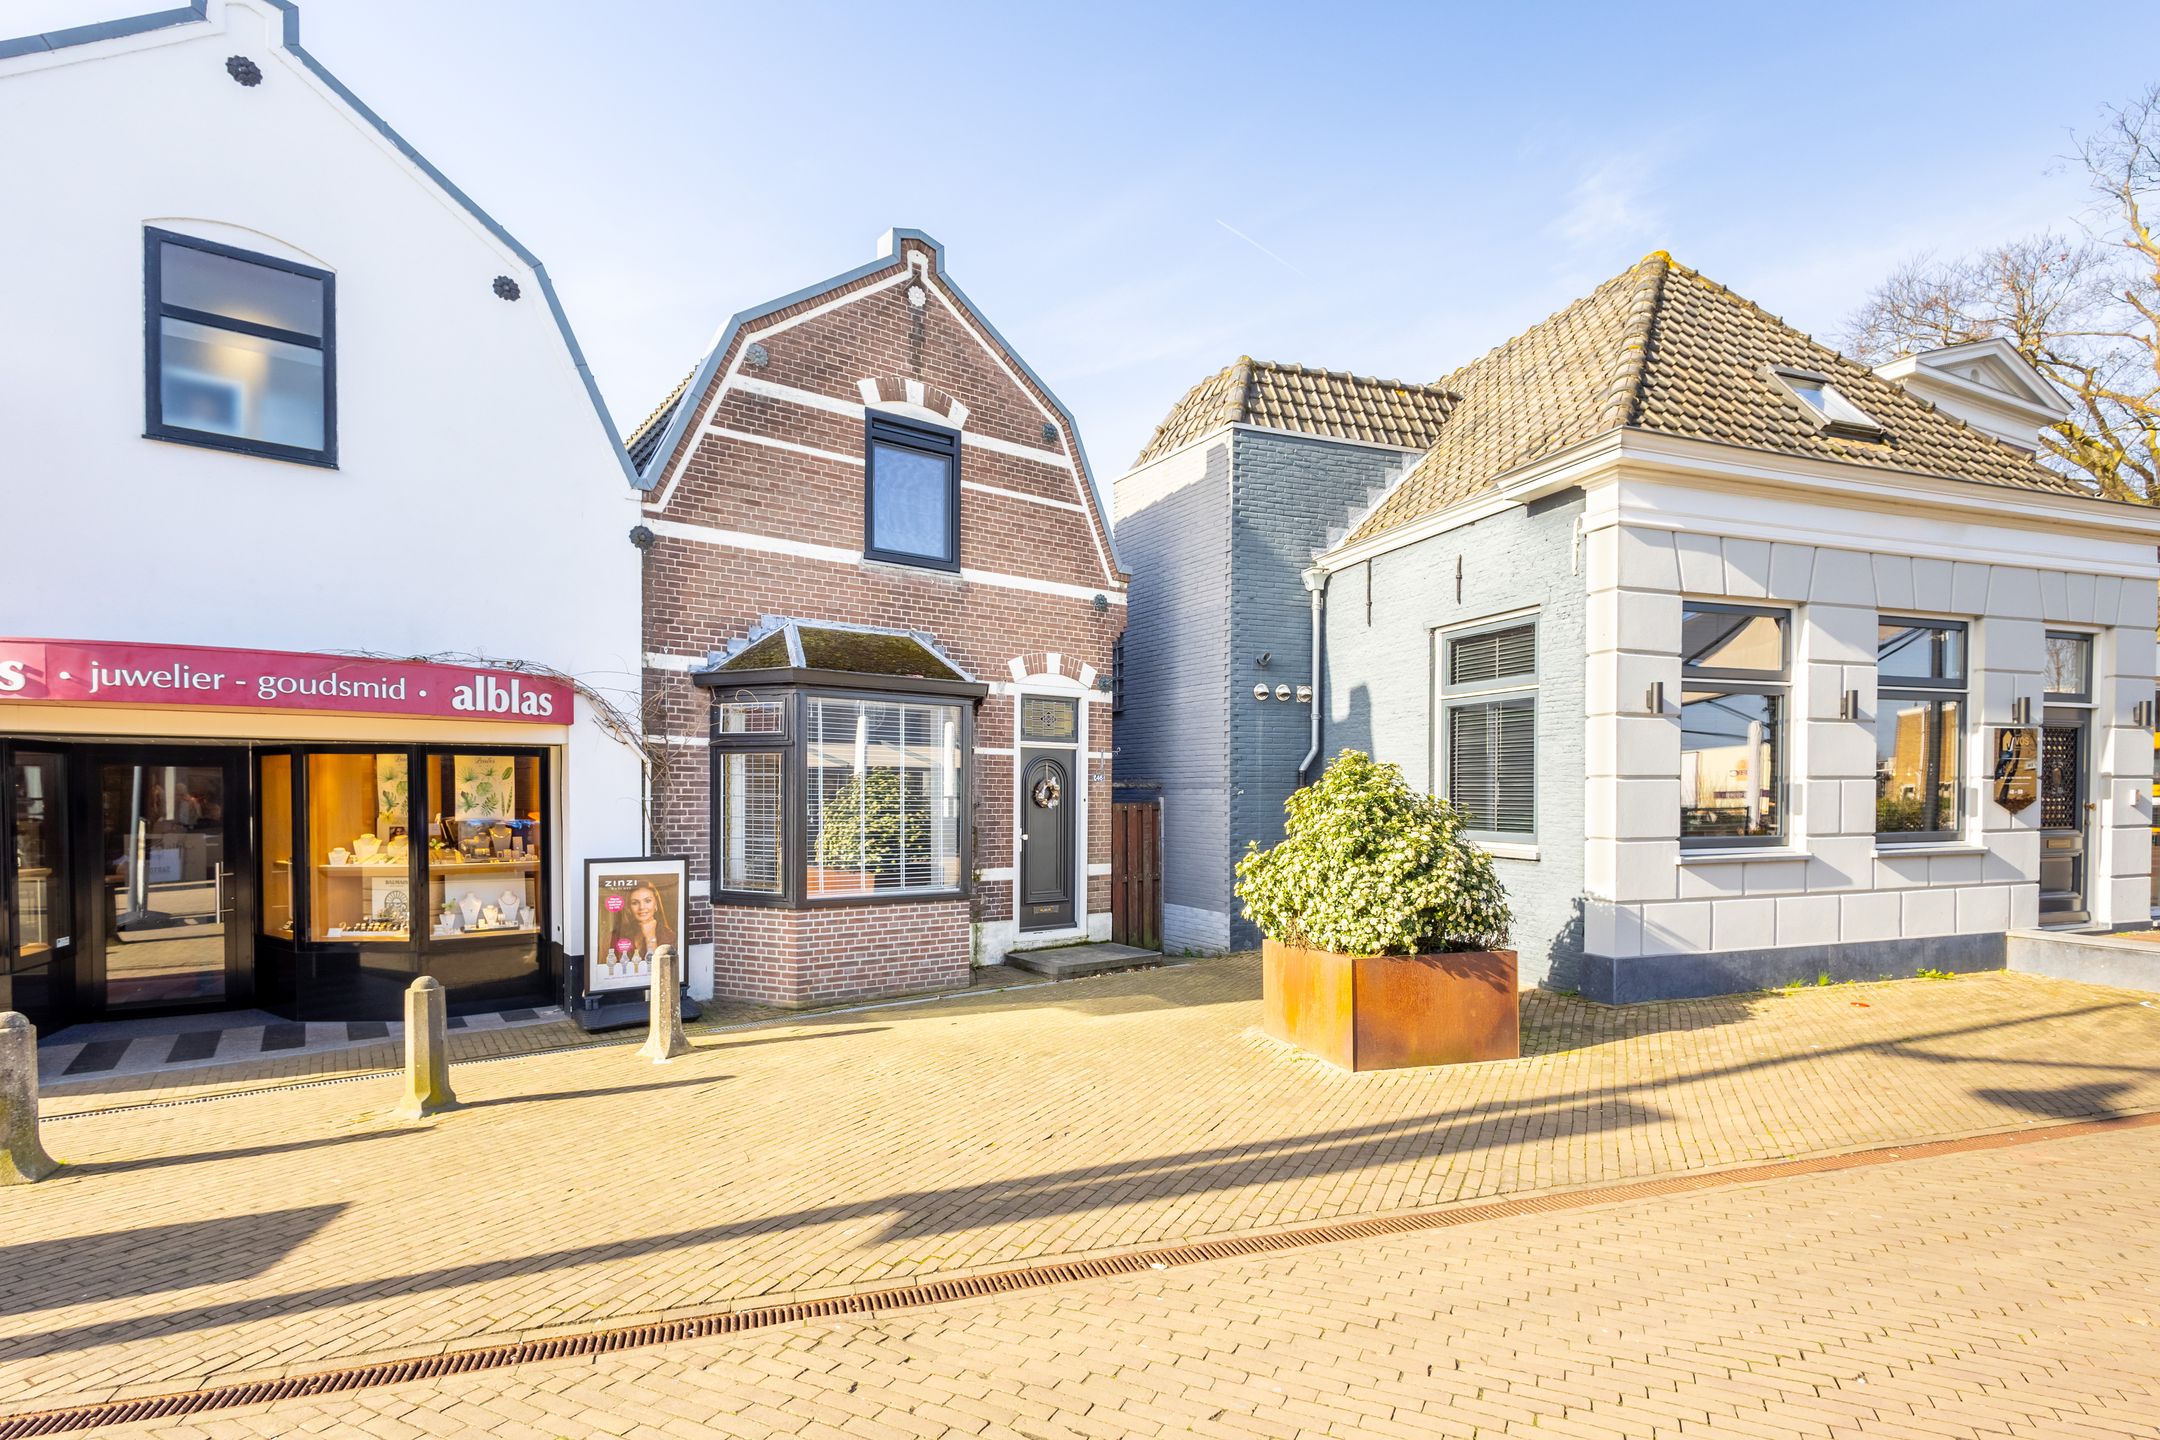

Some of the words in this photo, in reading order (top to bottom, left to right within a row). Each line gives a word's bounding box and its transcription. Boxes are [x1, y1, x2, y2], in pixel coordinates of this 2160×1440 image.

[89, 661, 225, 693] juwelier
[257, 673, 406, 700] goudsmid
[451, 674, 554, 716] alblas
